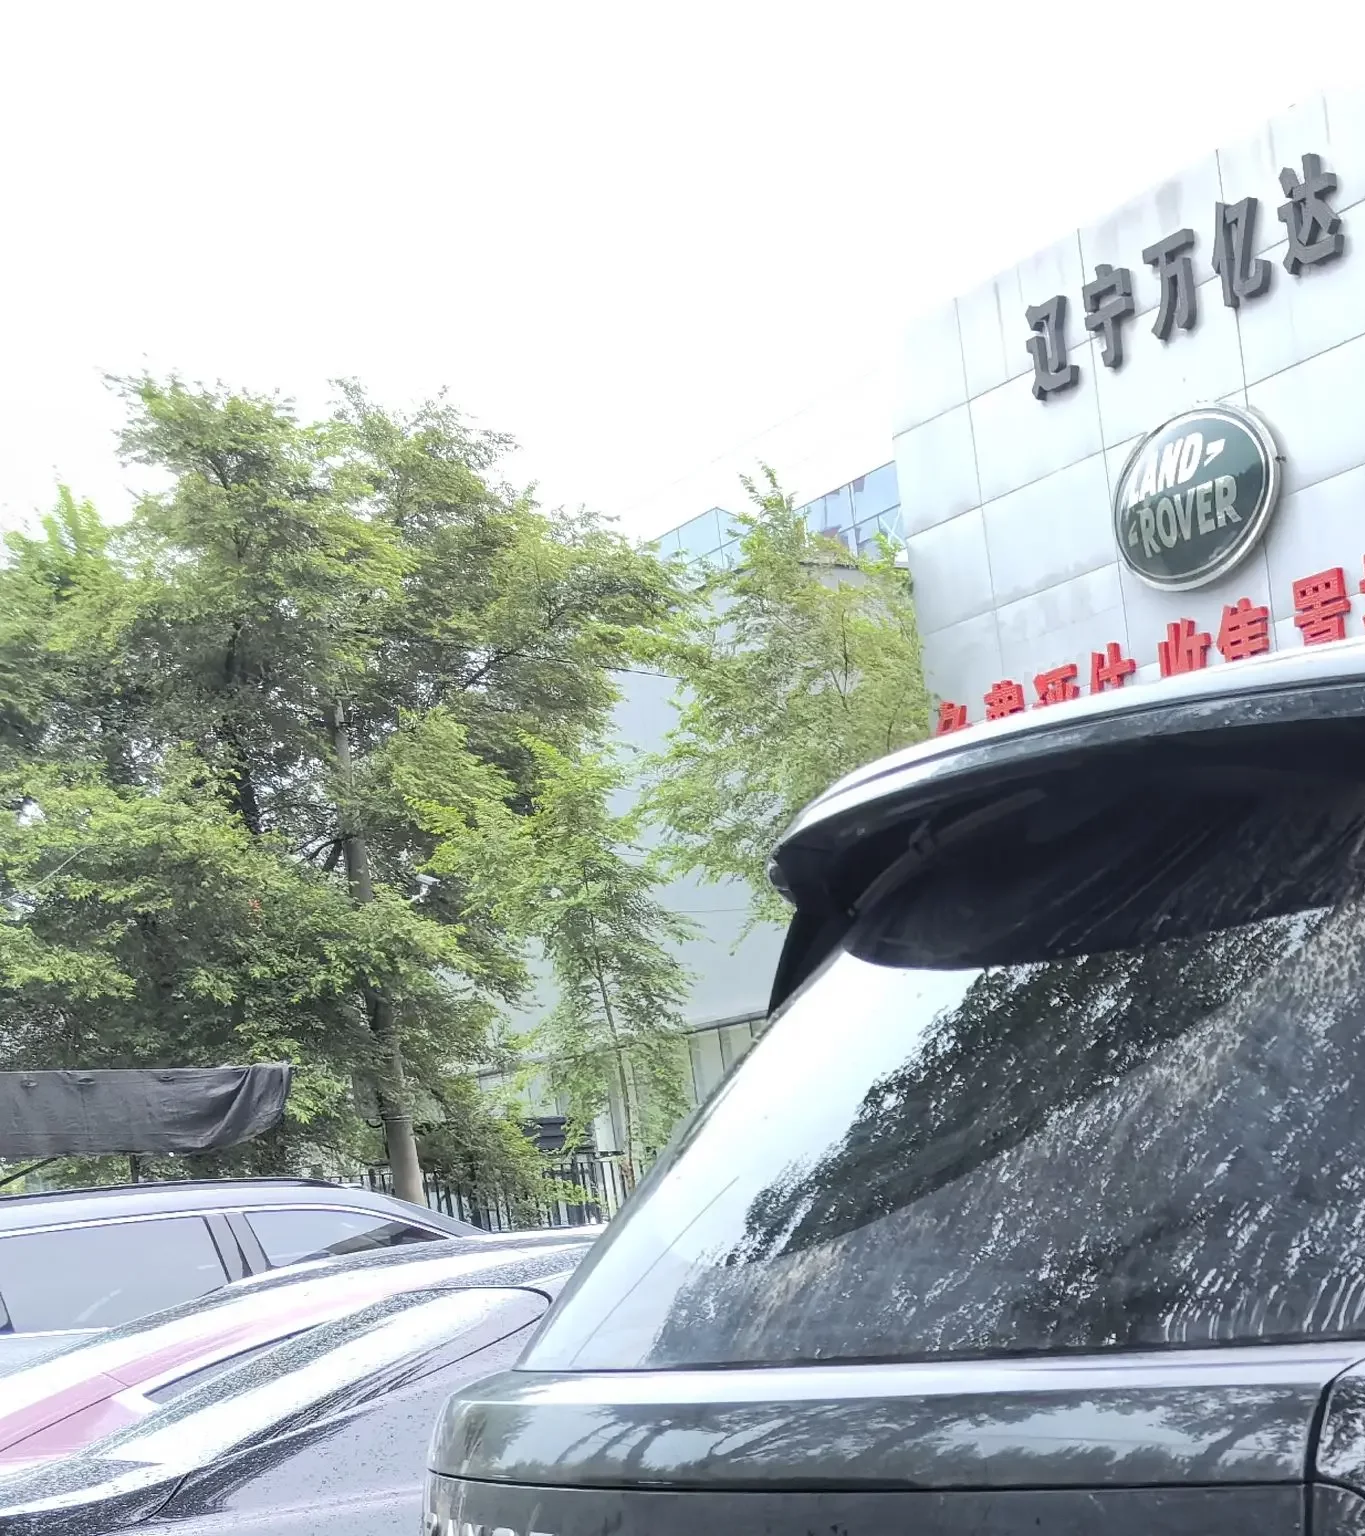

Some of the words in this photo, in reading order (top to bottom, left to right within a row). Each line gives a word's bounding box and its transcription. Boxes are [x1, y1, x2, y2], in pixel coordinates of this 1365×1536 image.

[1025, 153, 1345, 401] 辽宁万亿达
[1136, 475, 1242, 558] ROVER
